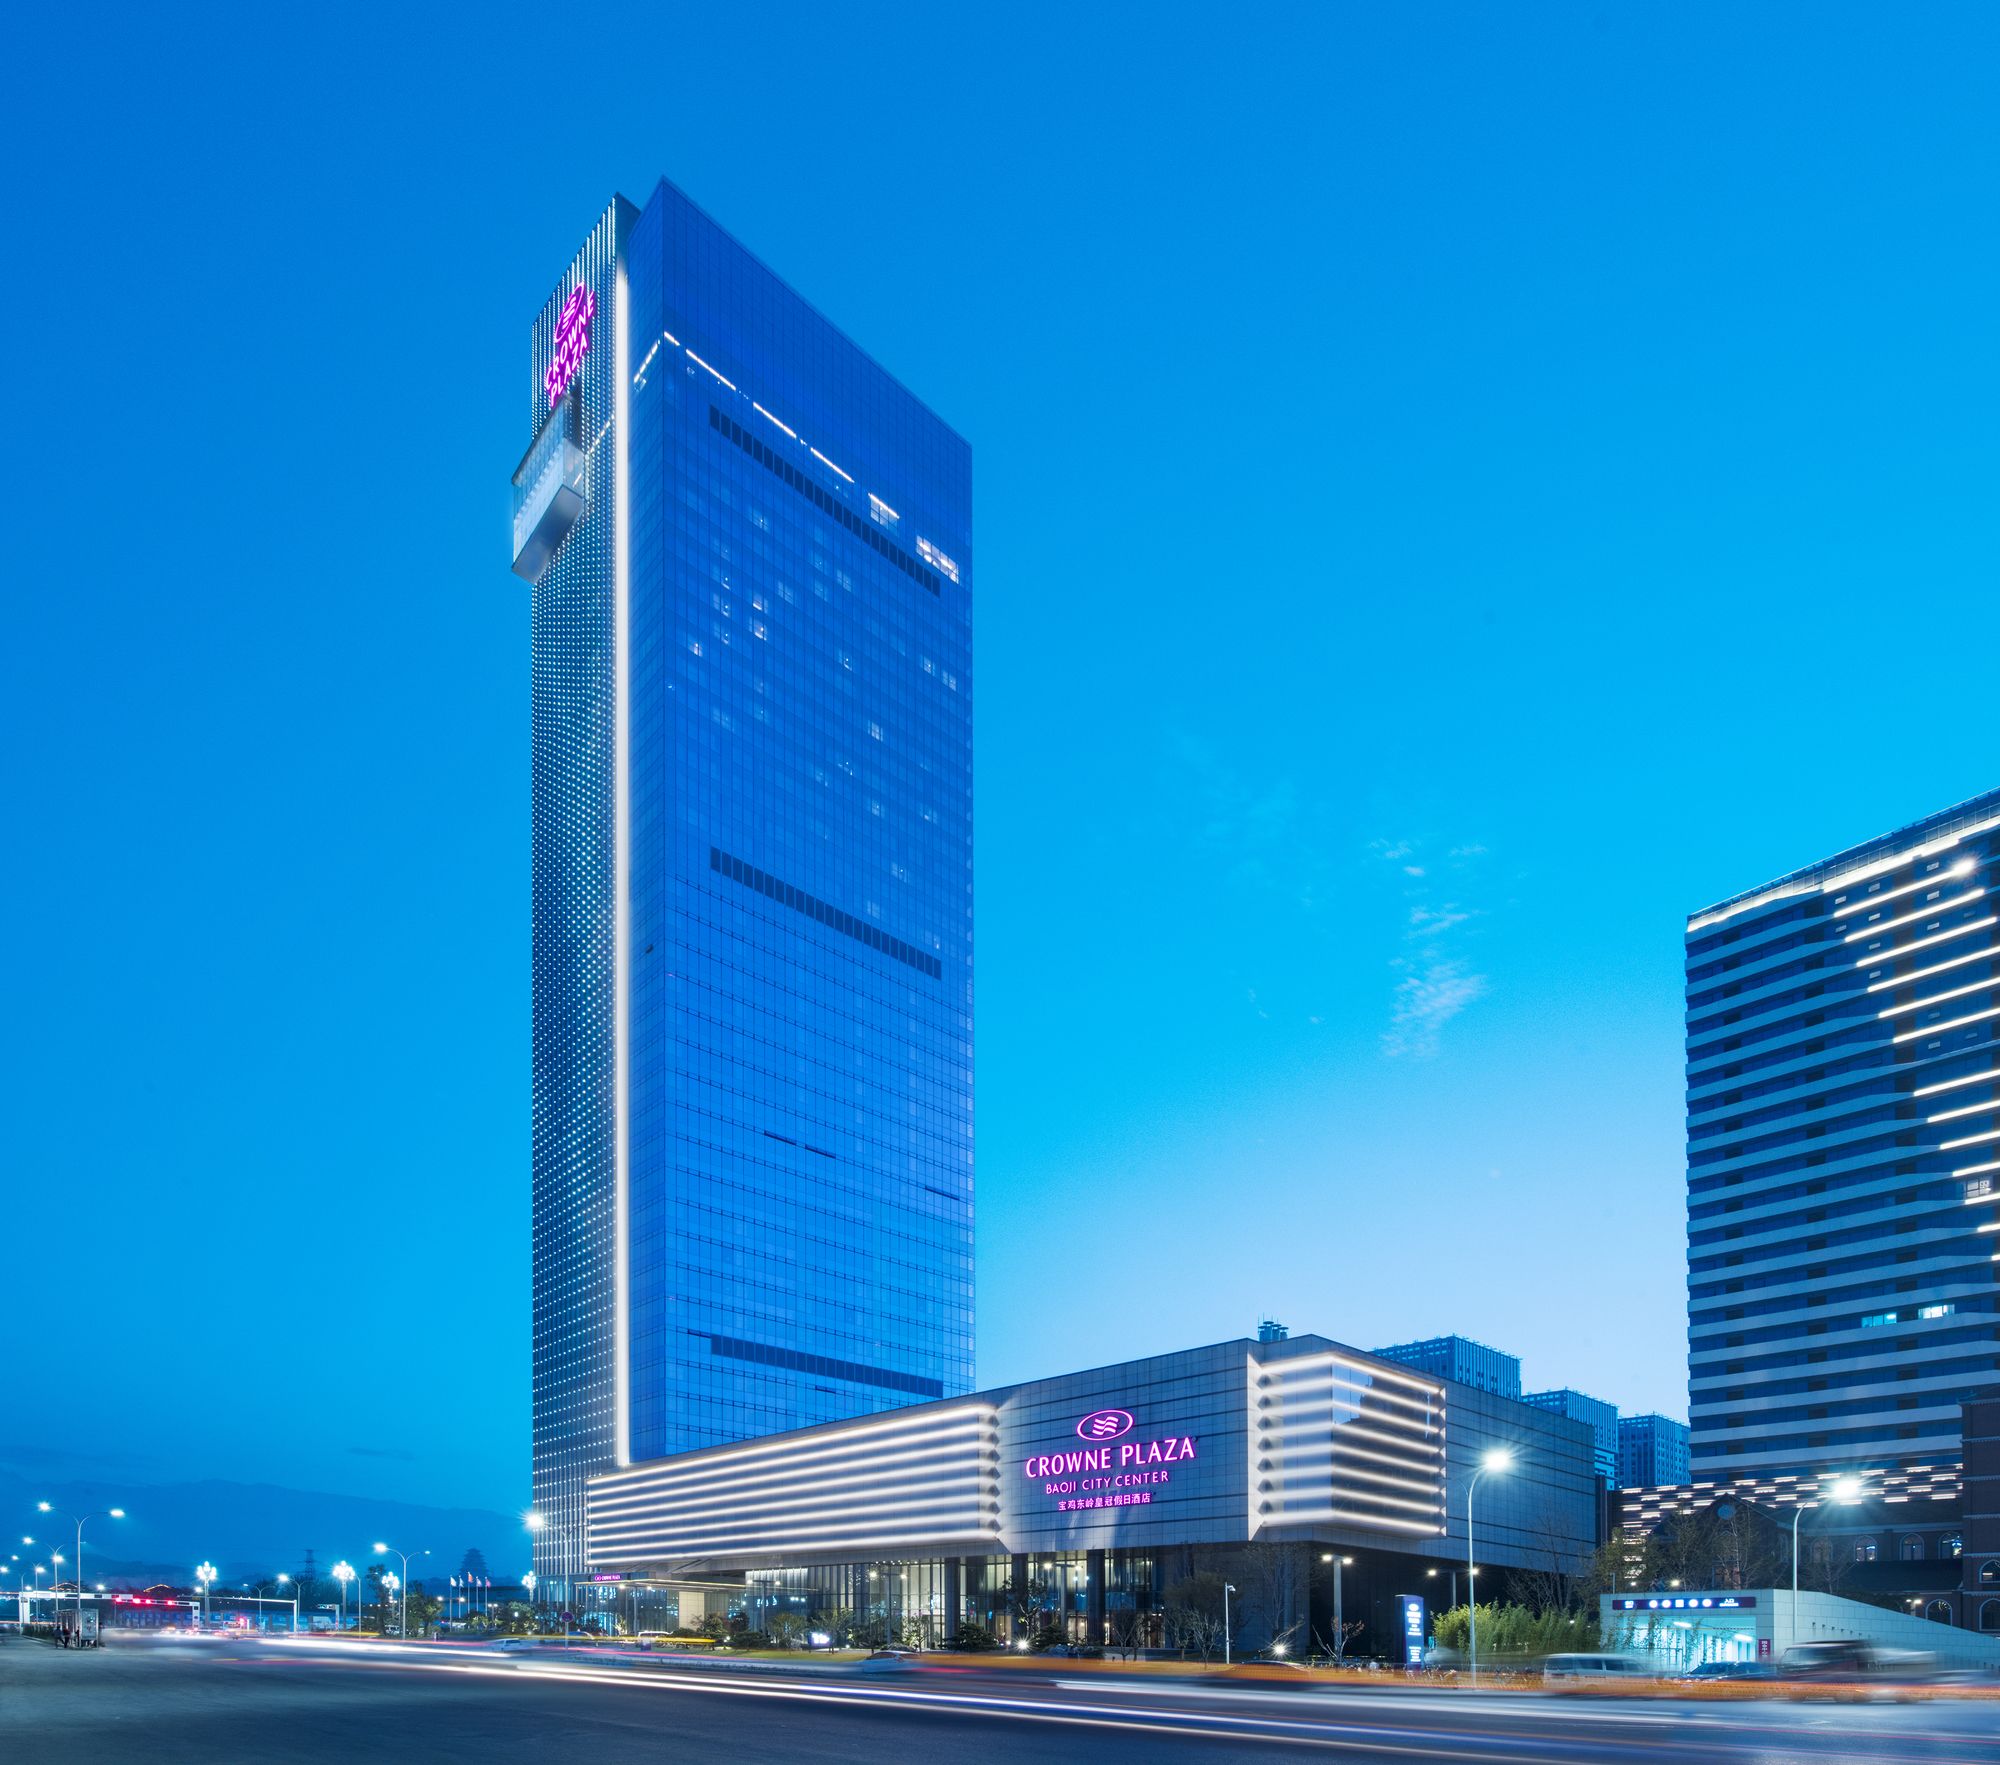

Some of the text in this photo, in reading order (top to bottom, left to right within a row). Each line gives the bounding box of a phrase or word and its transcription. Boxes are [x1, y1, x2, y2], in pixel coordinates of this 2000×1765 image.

[545, 290, 594, 391] CROWNE
[550, 332, 588, 408] PLAZA
[1026, 1437, 1195, 1478] CROWNE PLAZA
[1046, 1470, 1169, 1495] BAOJI CITY CENTER
[1058, 1493, 1151, 1511] 宝鸡东岭皇冠假日酒店
